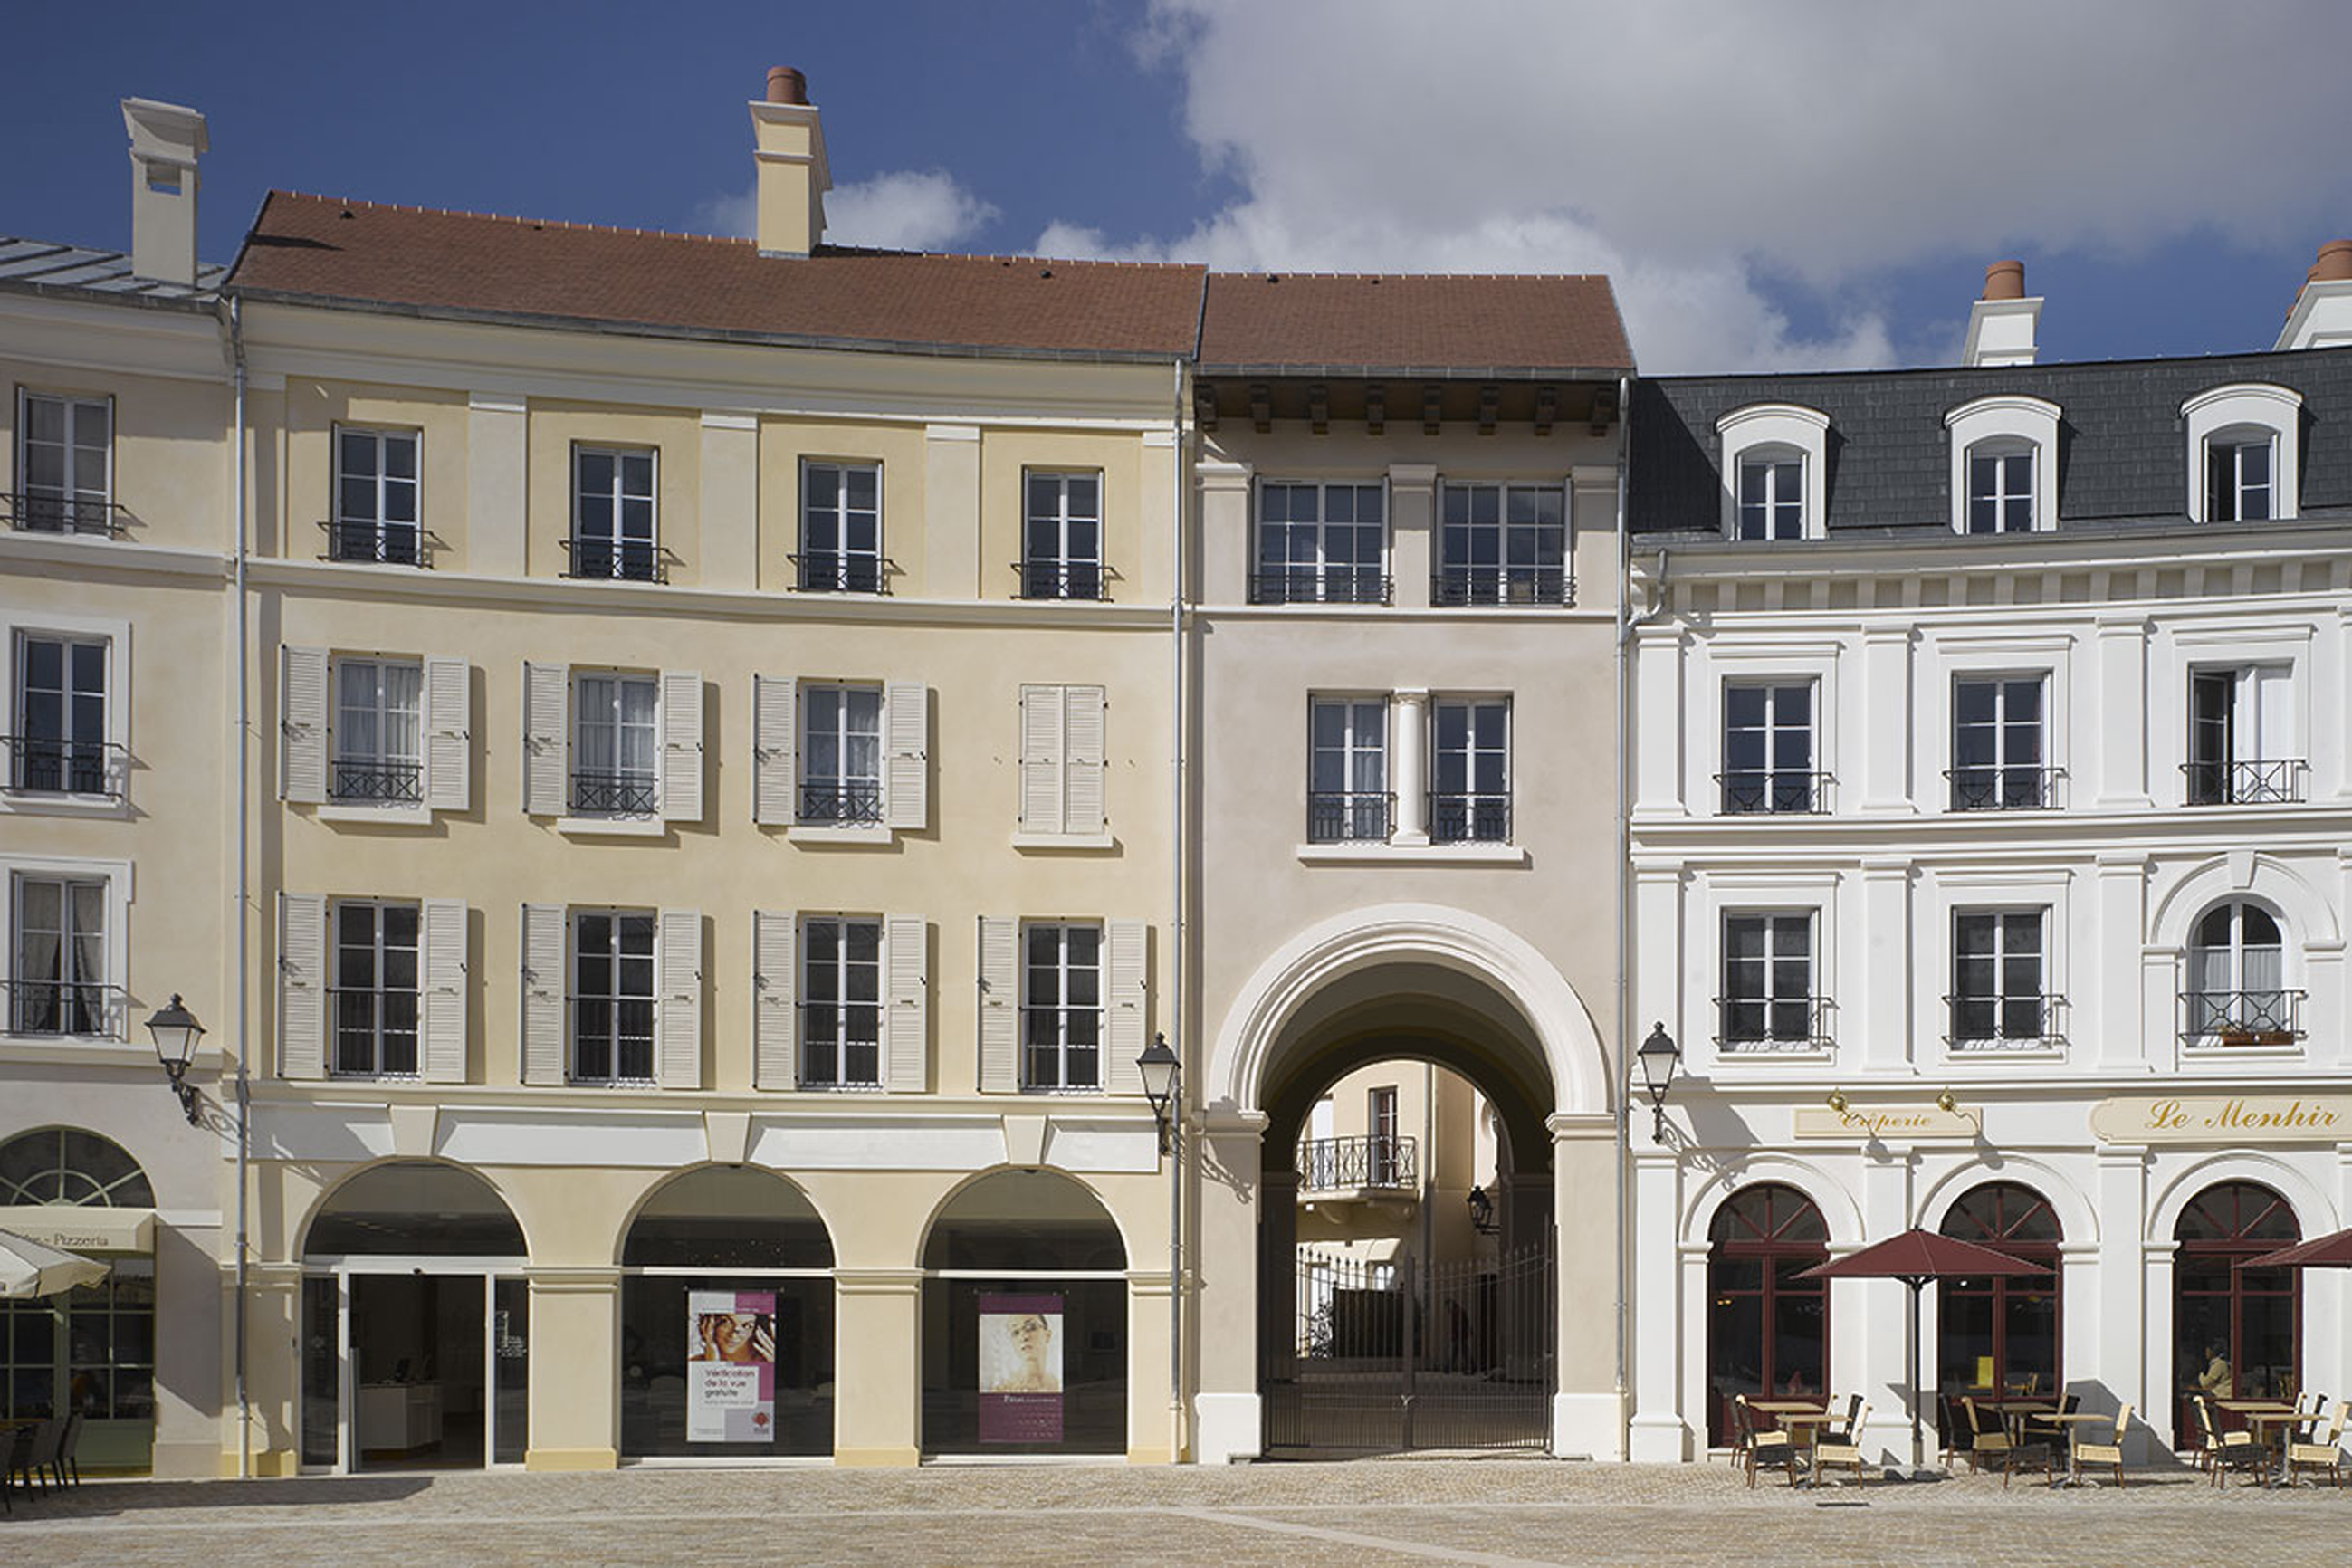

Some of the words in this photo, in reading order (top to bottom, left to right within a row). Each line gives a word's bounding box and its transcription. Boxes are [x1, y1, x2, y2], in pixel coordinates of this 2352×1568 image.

[2145, 1099, 2192, 1129] Le
[2204, 1099, 2341, 1128] Menhir
[54, 1233, 109, 1246] Pizzeria
